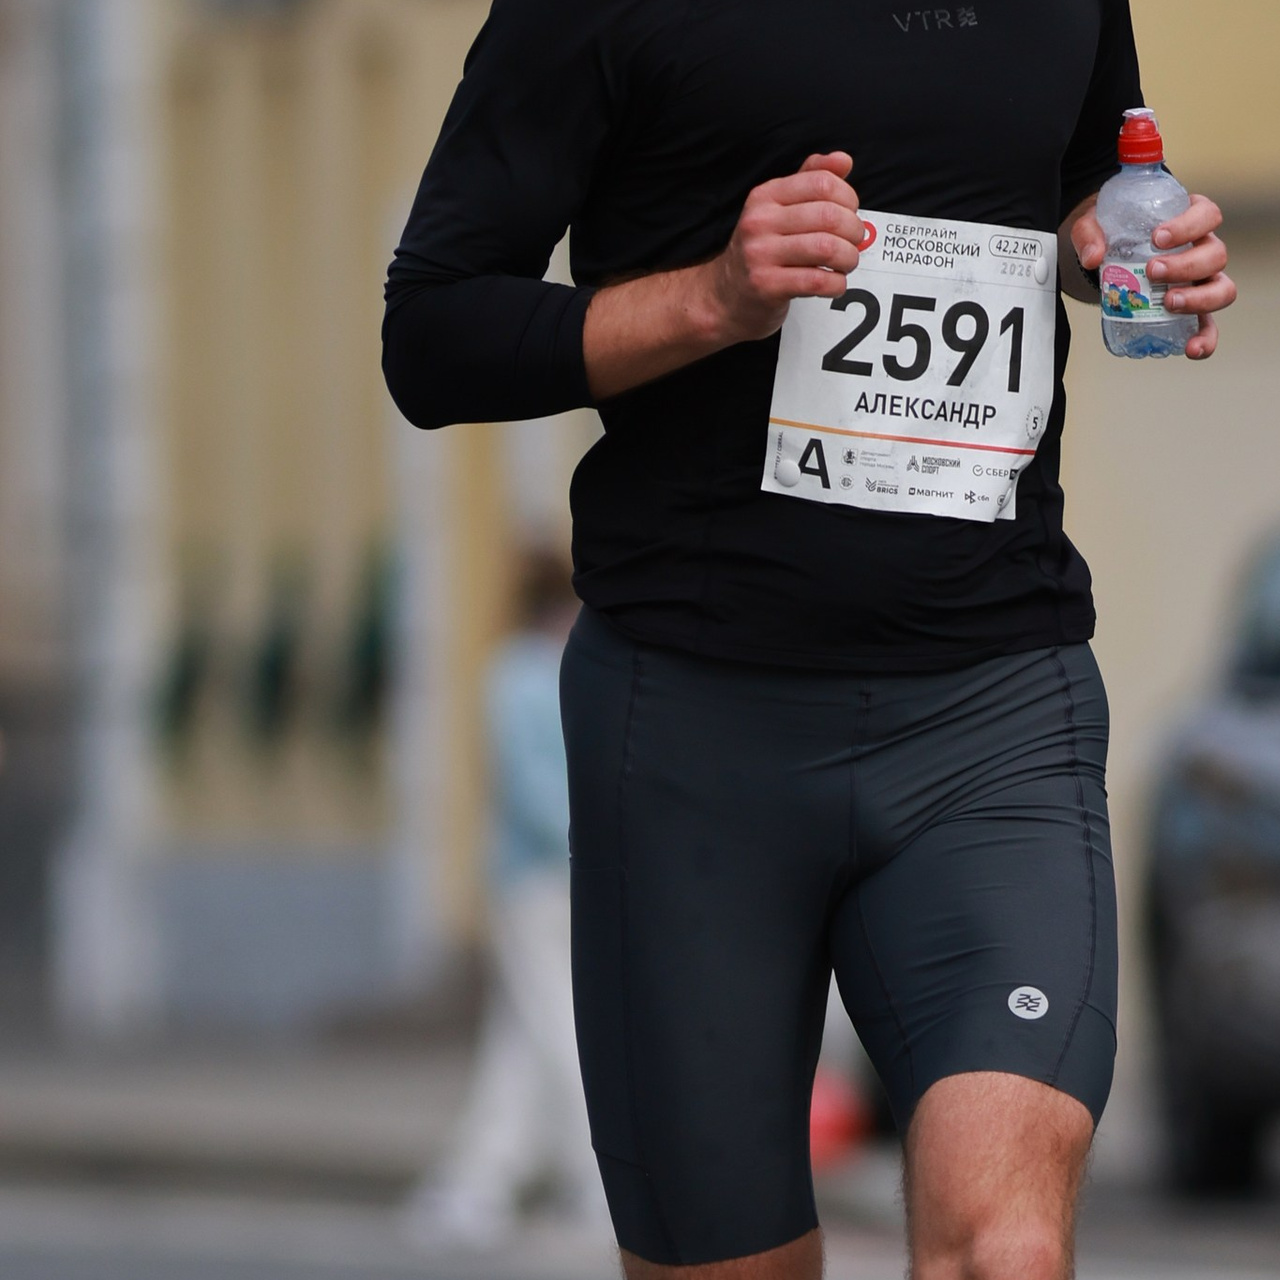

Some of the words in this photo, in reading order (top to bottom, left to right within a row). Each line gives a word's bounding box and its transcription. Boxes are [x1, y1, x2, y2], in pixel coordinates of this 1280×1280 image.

[891, 8, 954, 32] VTR
[886, 223, 957, 239] СБЕРПРАЙМ
[883, 235, 980, 257] МОСКОВСКИЙ
[995, 239, 1019, 255] 42,2
[881, 250, 955, 269] МАРАФОН
[1000, 262, 1032, 278] 2026
[821, 288, 1024, 393] 2591
[854, 391, 997, 429] АЛЕКСАНДР
[1032, 416, 1039, 430] 5
[921, 465, 940, 475] СПОРТ
[922, 456, 961, 468] МОСКОВСКИЙ
[985, 467, 1009, 478] СБЕР
[876, 486, 899, 495] BRICS
